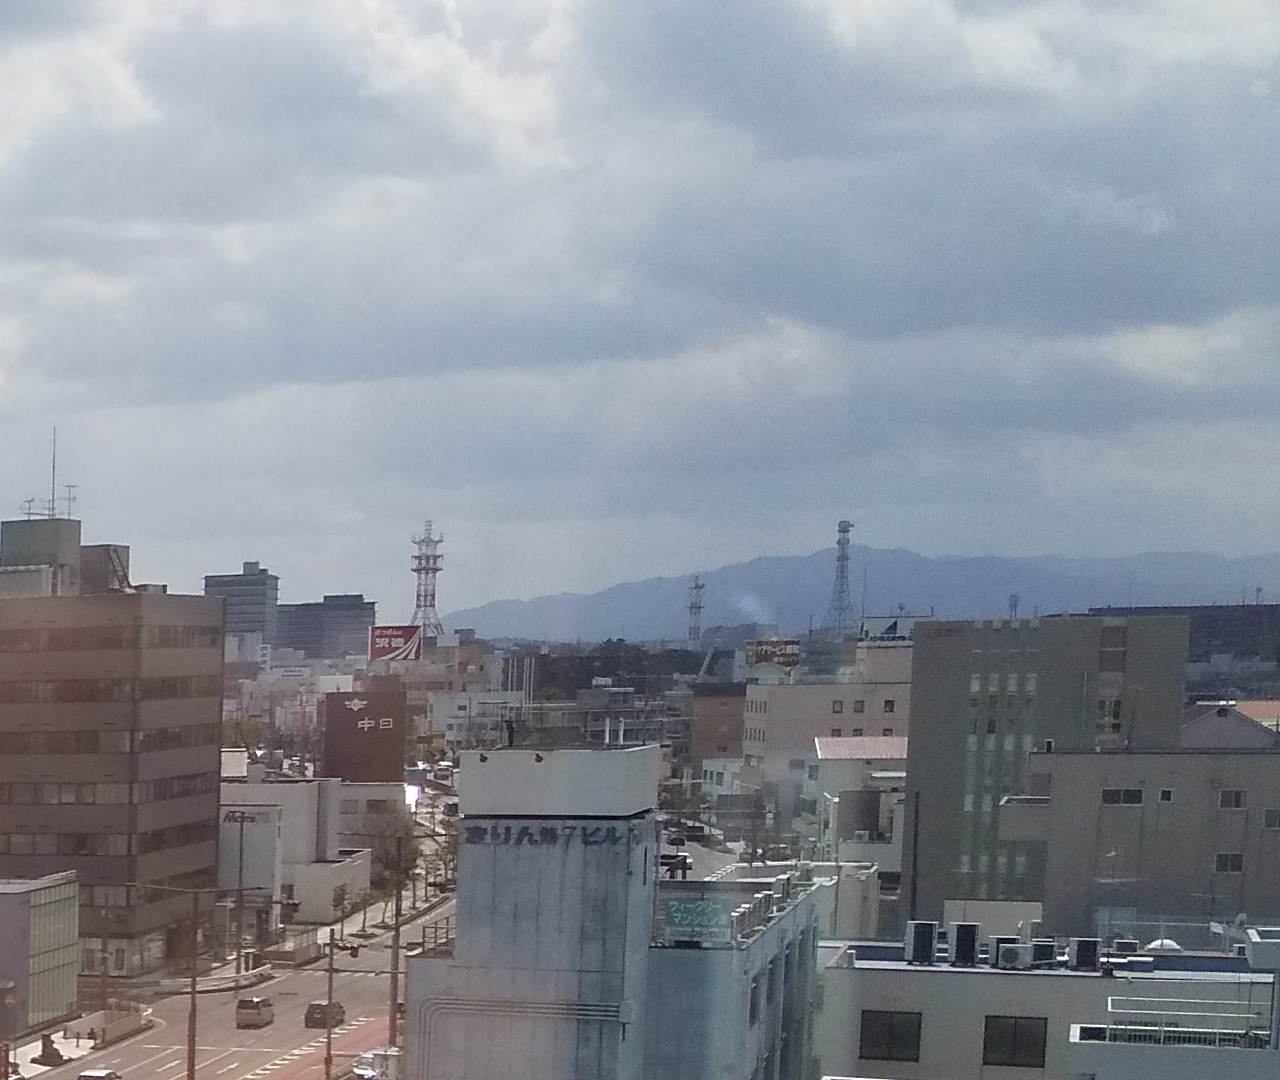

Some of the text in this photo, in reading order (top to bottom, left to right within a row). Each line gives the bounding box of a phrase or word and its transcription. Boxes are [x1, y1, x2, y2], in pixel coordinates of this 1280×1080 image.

[668, 900, 722, 913] ウィークリー
